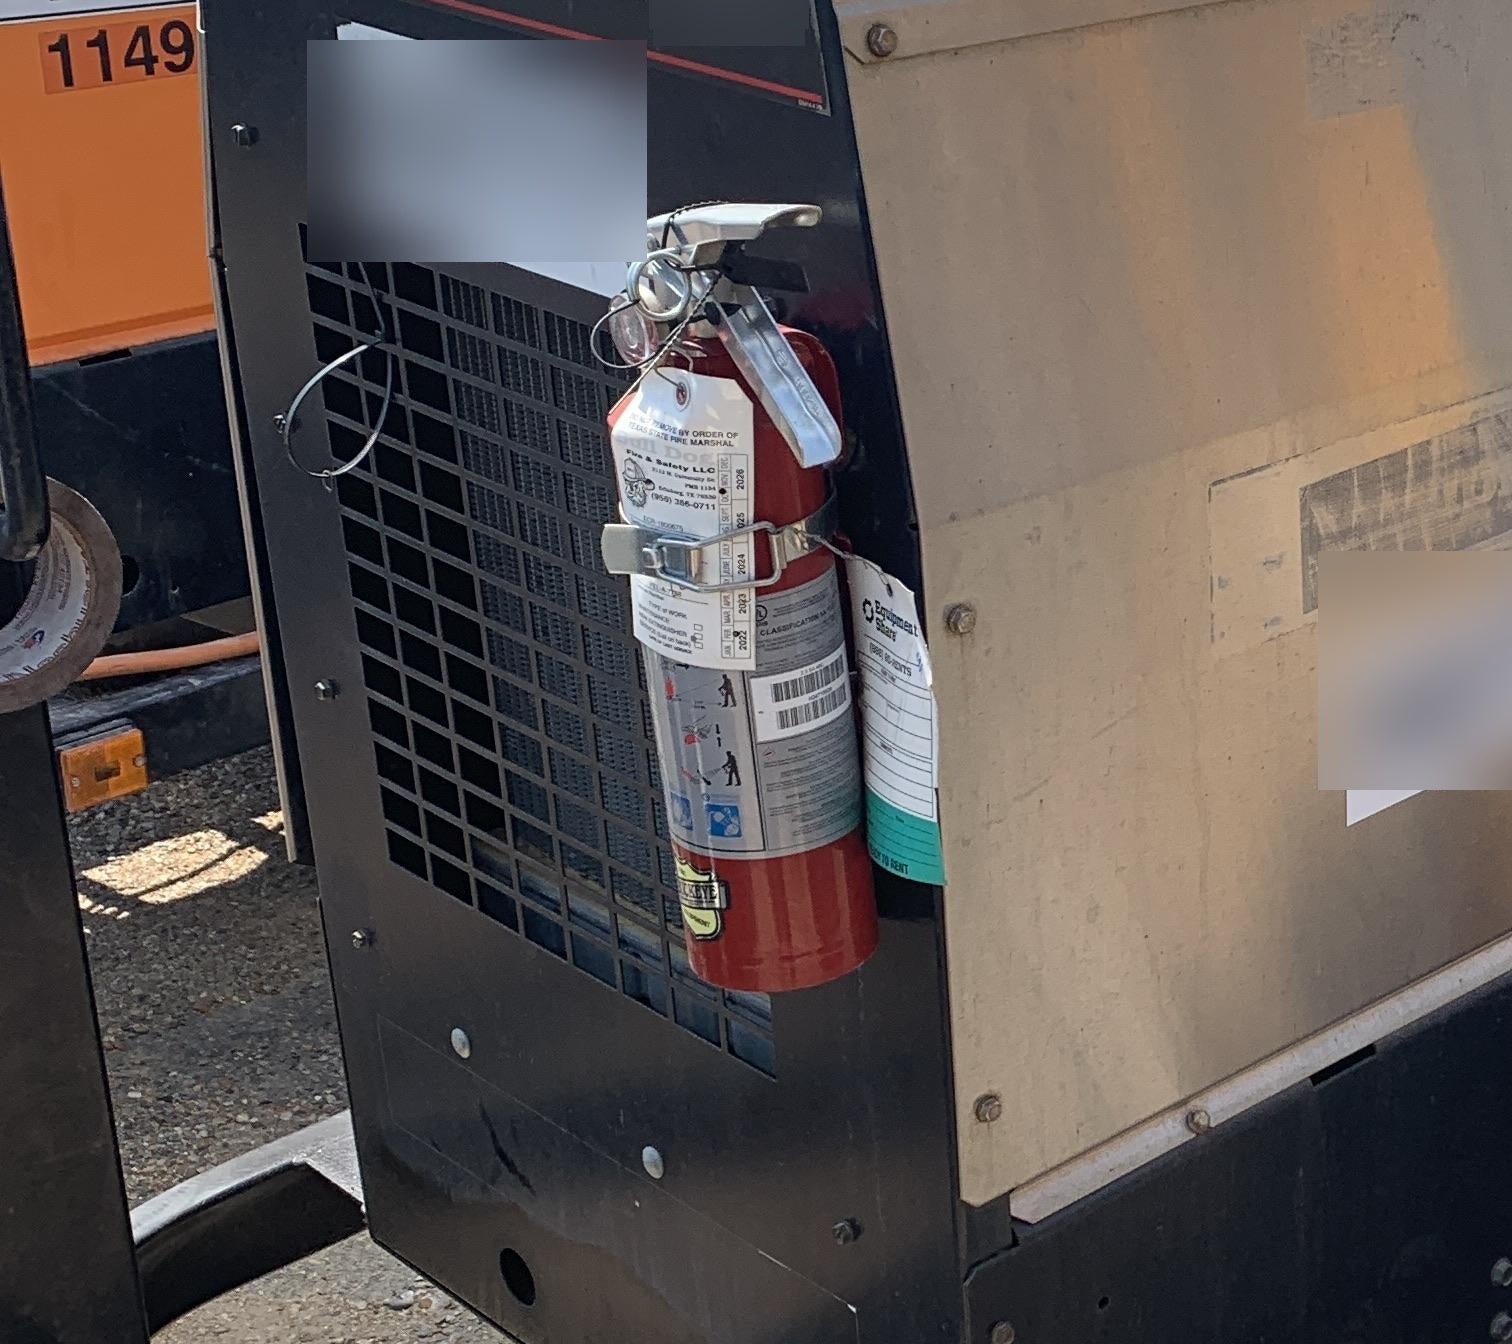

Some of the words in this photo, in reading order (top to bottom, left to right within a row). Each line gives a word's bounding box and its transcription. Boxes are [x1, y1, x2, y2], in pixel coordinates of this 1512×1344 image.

[48, 20, 195, 88] 1149
[690, 439, 735, 447] MARSHAL
[692, 430, 723, 439] ORDER
[656, 459, 689, 472] Safety
[692, 466, 716, 474] LLC
[736, 469, 745, 490] 2026
[737, 553, 746, 575] 2024
[875, 599, 919, 637] Equipment
[876, 617, 897, 642] Share
[738, 630, 747, 651] 2022
[890, 856, 909, 875] RENT
